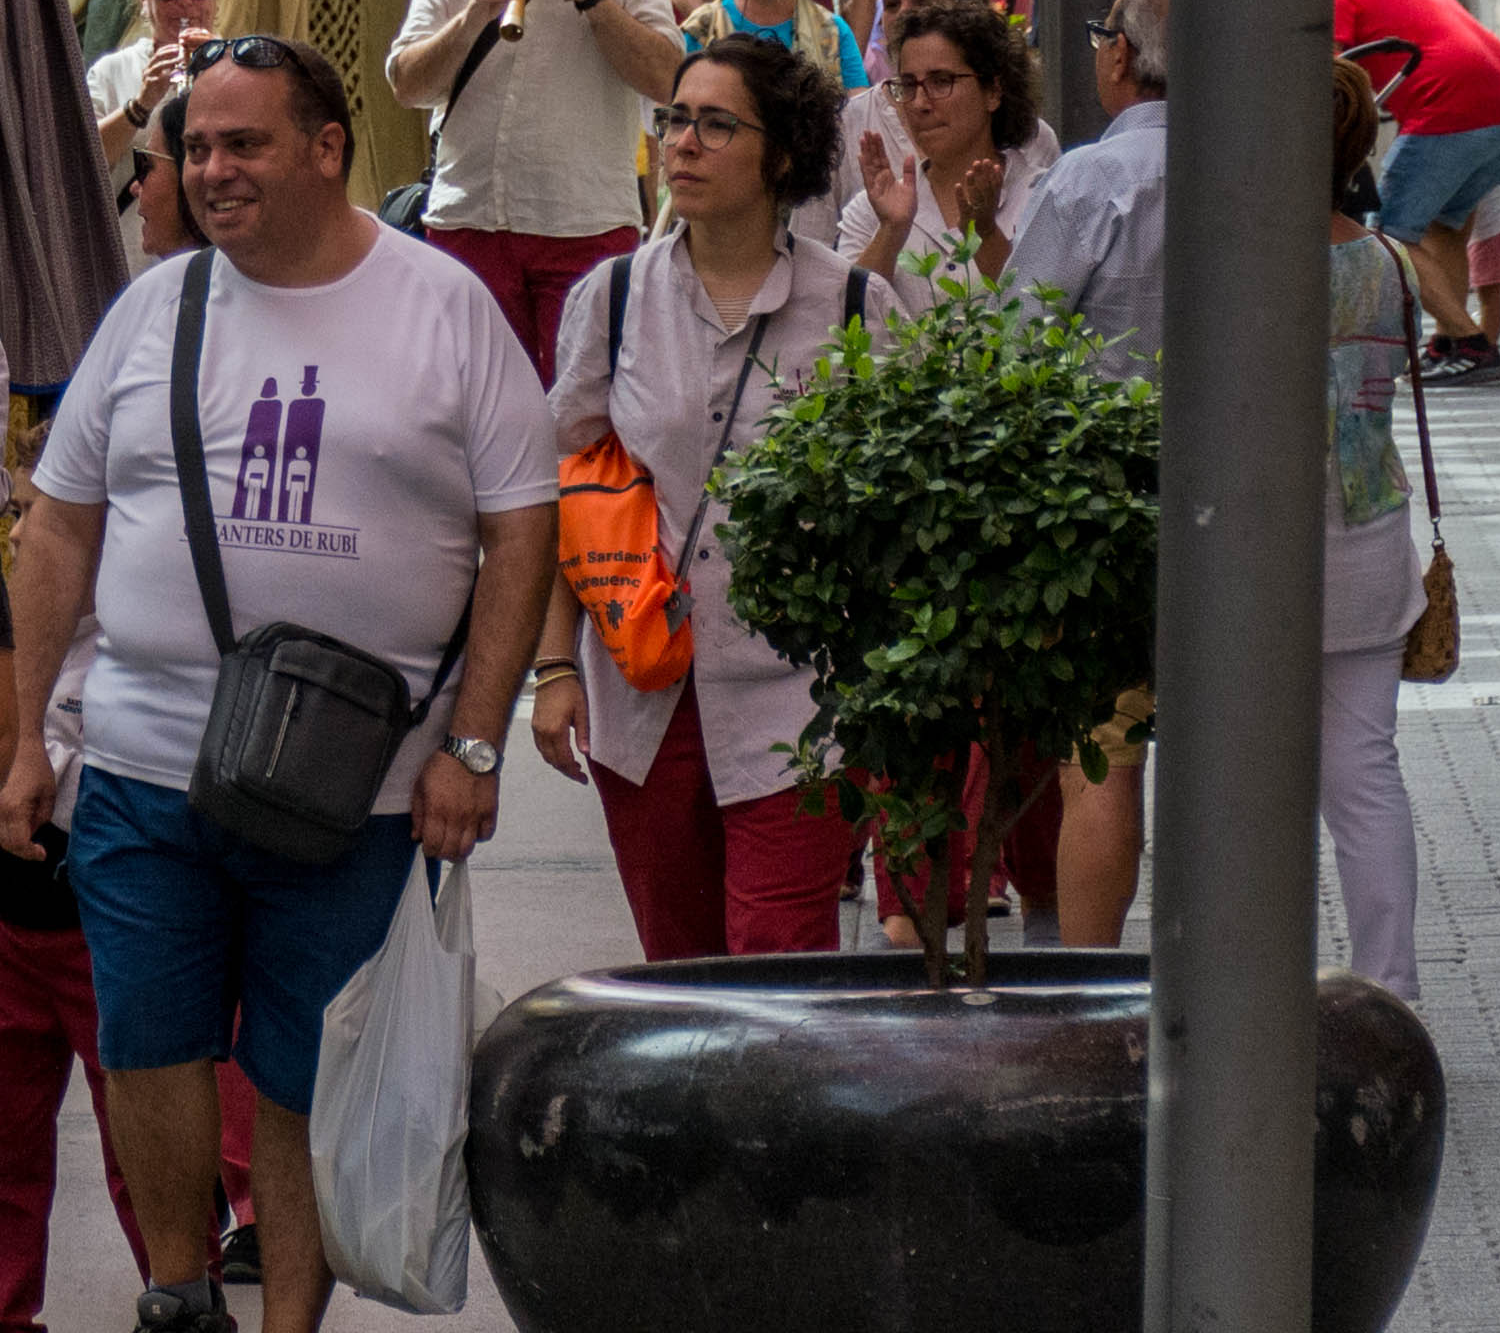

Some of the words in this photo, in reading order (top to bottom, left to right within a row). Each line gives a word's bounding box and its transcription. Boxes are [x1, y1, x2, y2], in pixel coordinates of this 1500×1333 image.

[185, 523, 285, 547] ANTERS
[289, 529, 313, 549] DE
[317, 531, 358, 555] RUBÍ
[587, 550, 652, 564] Sardani
